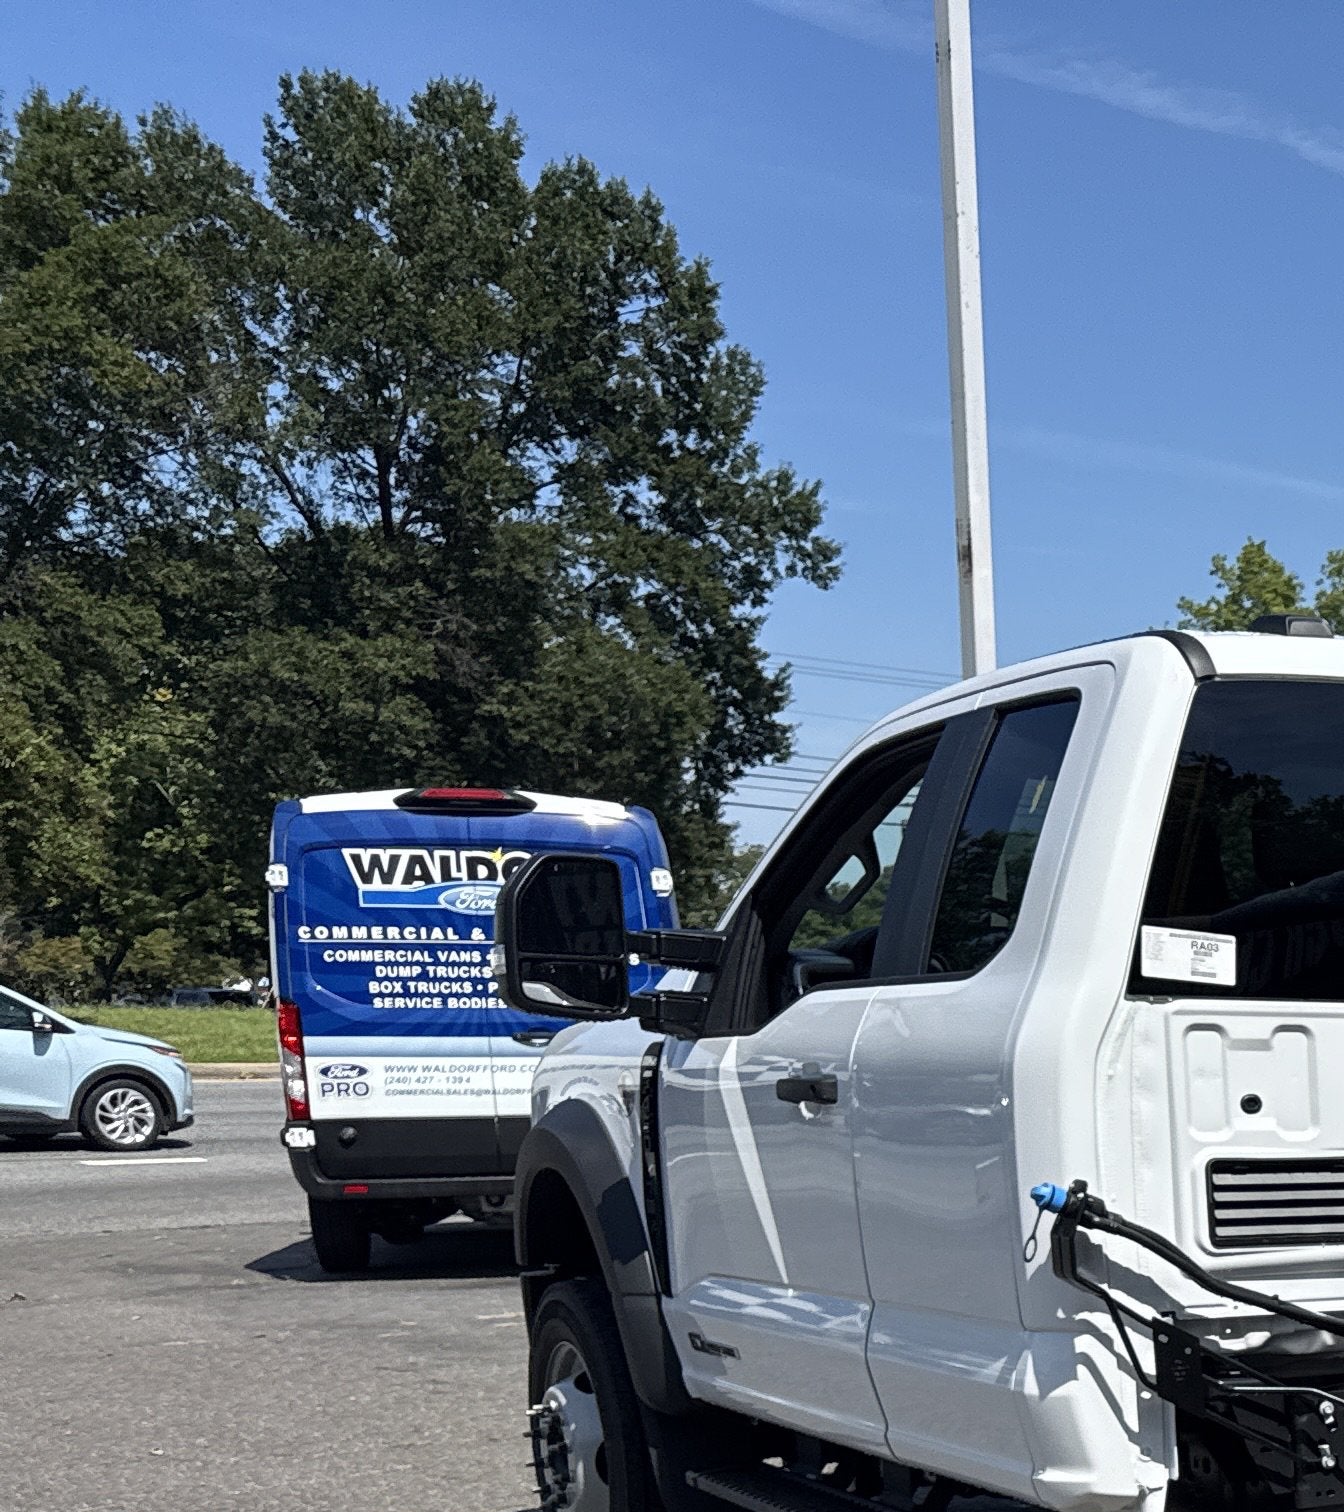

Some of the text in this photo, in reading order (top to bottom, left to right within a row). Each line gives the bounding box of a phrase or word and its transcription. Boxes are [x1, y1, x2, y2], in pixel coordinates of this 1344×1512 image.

[298, 926, 486, 940] COMMERCIAL &
[323, 950, 434, 963] COMMERCIAL
[437, 951, 482, 963] VANS
[375, 965, 493, 978] DUMP TRUCKS
[368, 981, 404, 994] BOX
[407, 981, 473, 994] TRUCKS
[373, 997, 443, 1009] SERVICE
[321, 1082, 370, 1097] PRO
